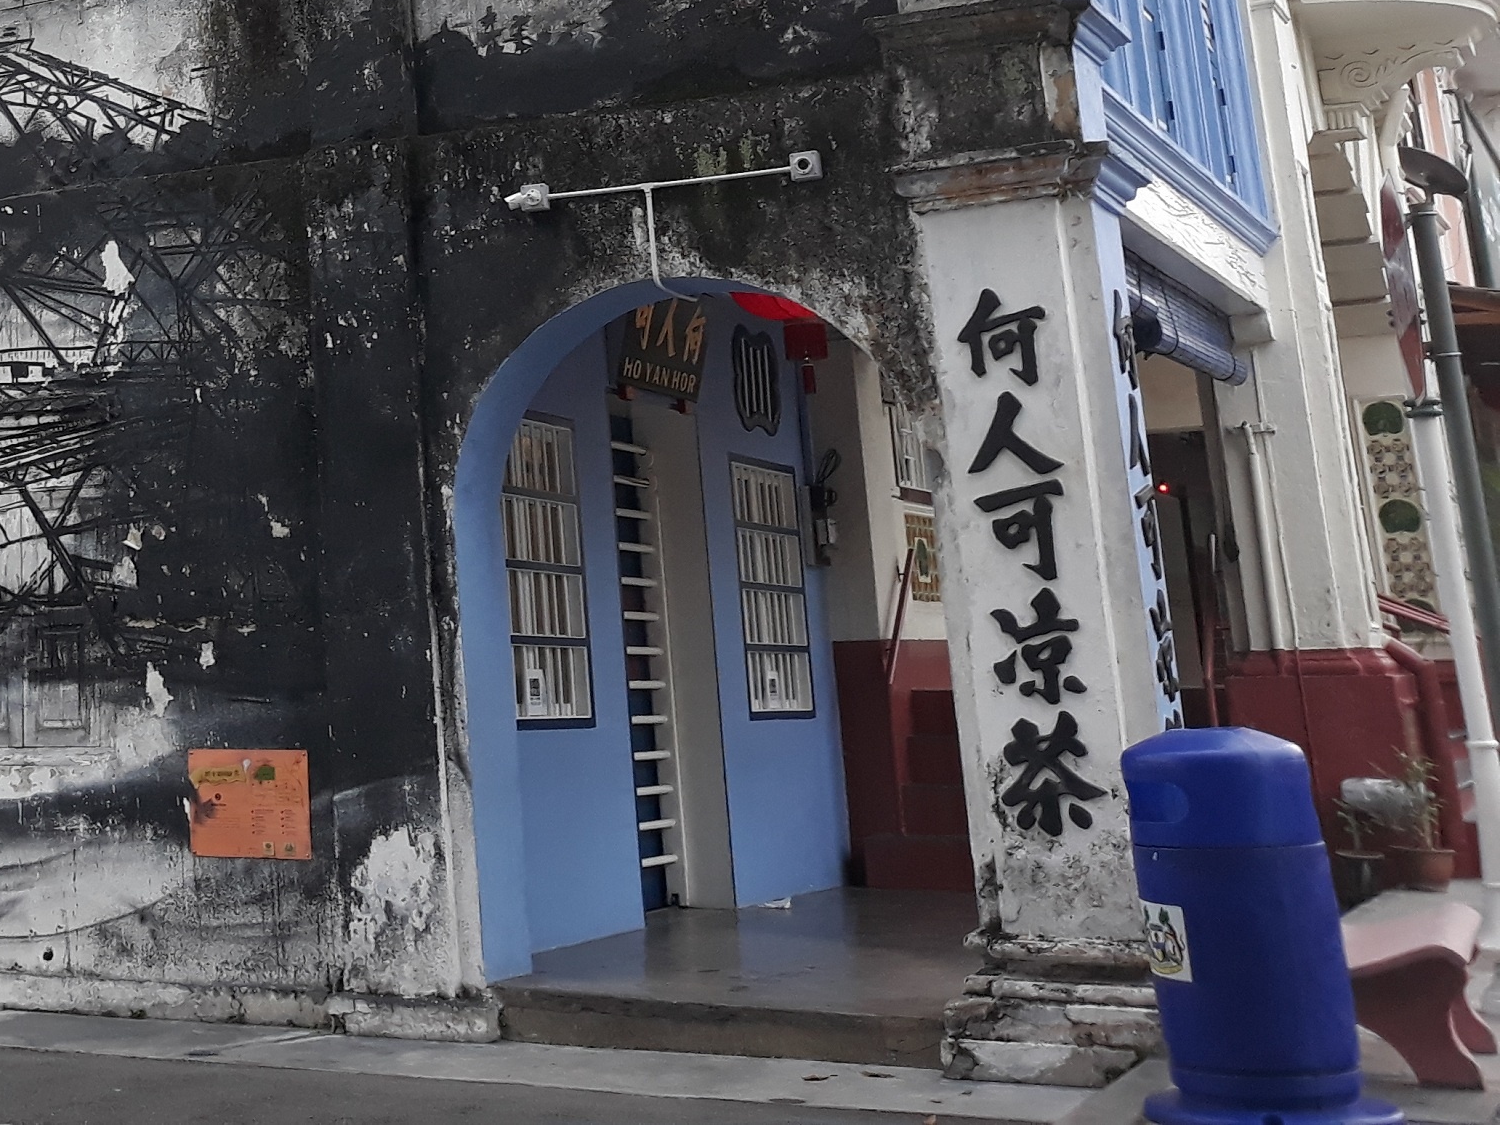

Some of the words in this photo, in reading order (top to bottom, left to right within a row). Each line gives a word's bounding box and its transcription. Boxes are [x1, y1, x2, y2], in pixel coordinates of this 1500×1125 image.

[623, 356, 642, 380] HO
[645, 362, 671, 387] YAN
[671, 370, 697, 394] HOR
[957, 288, 1108, 838] 何人可凉茶
